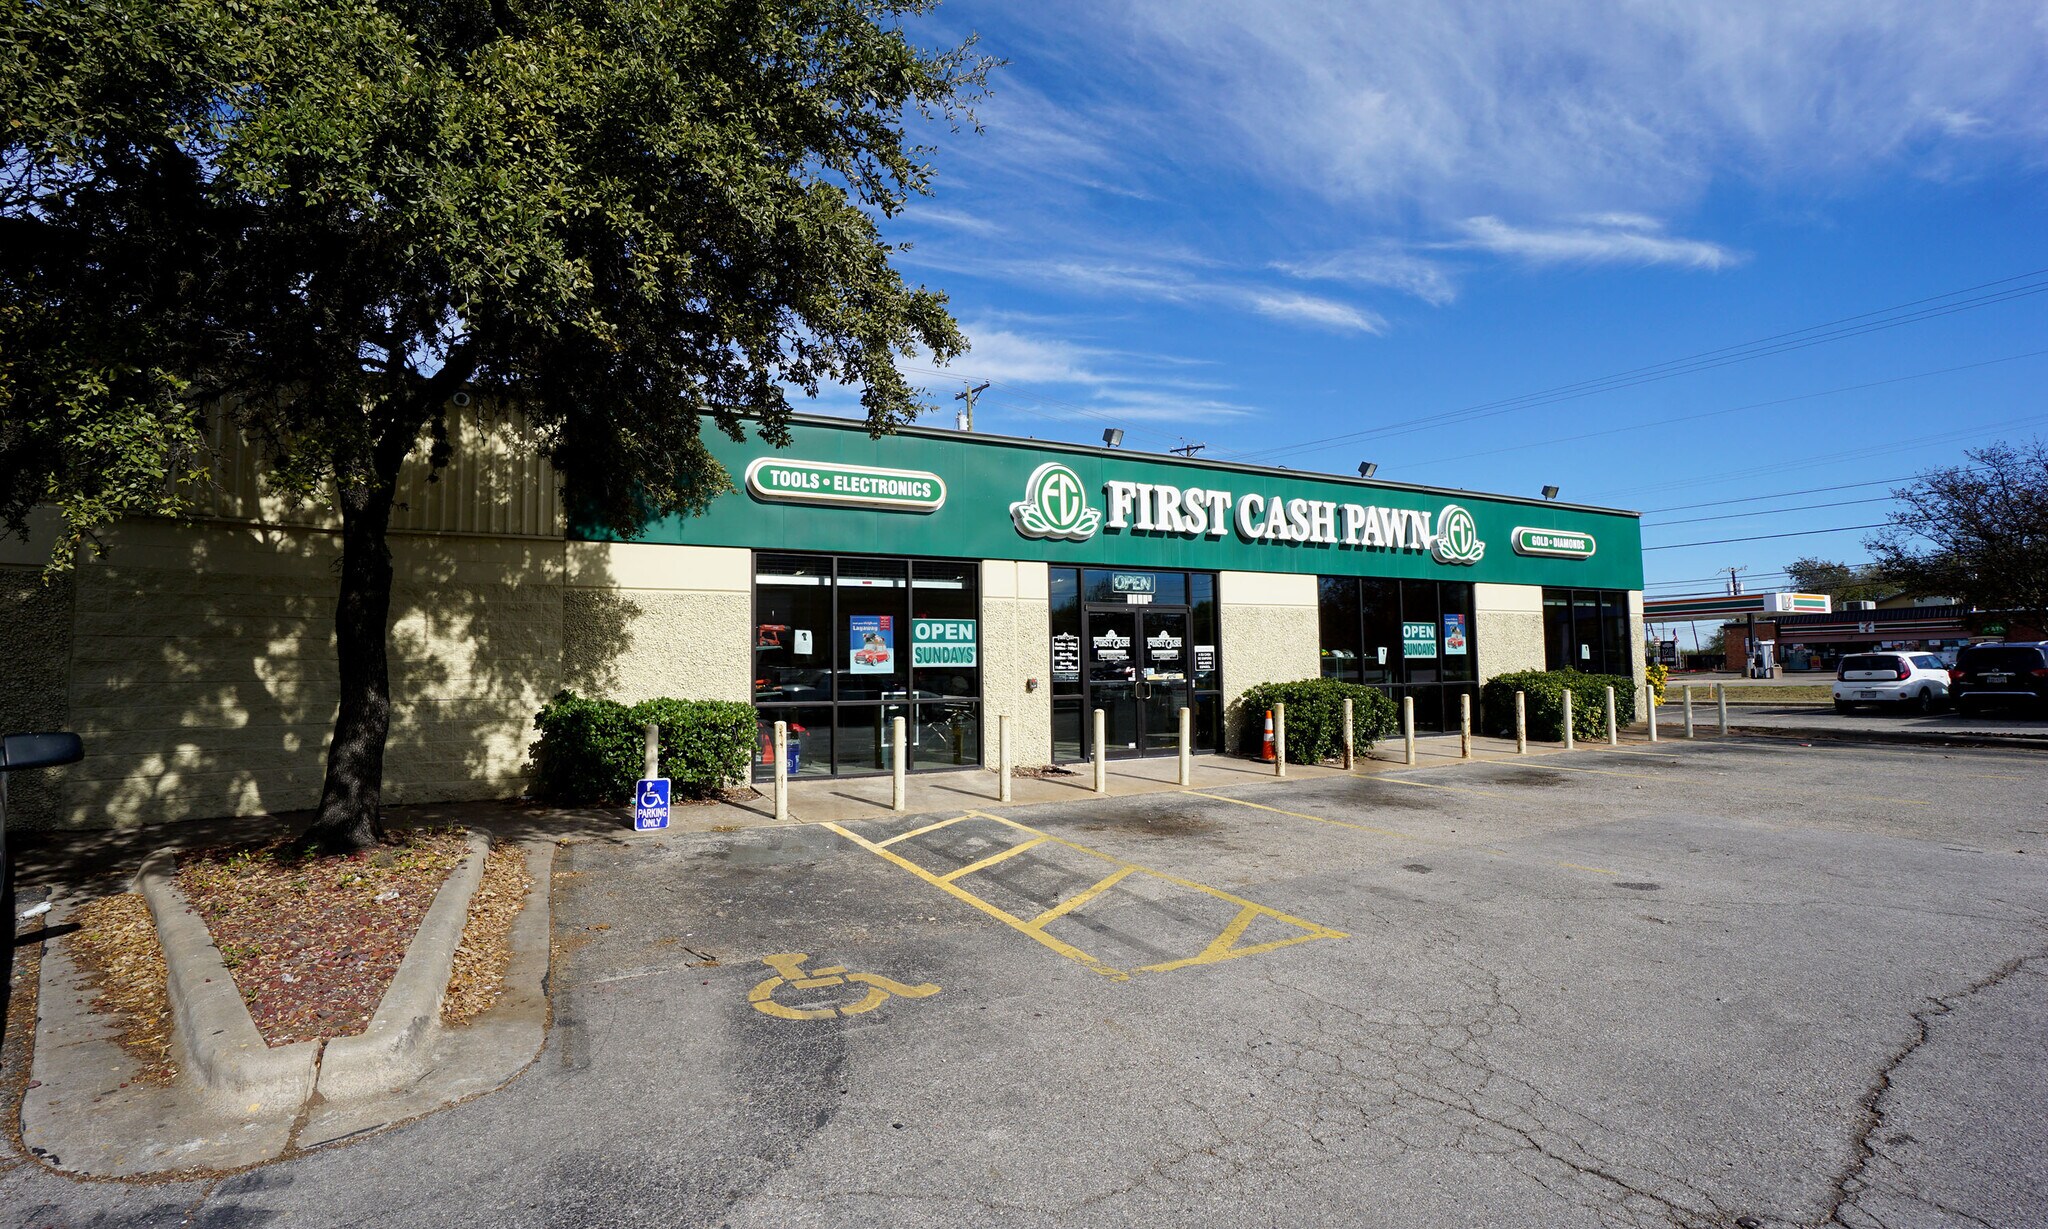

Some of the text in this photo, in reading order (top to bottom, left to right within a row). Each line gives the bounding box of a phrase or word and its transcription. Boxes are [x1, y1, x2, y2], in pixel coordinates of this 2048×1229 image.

[770, 469, 932, 498] TOOLS ELECTRONICS
[1105, 480, 1432, 550] FIRST CASH PAWN
[1531, 535, 1585, 550] GOLD DIAMONDS
[1114, 575, 1152, 591] OPEN
[915, 622, 973, 640] OPEN
[1403, 625, 1435, 638] OPEN
[915, 647, 974, 664] SUNDAYS
[1404, 643, 1435, 656] SUNDAYS
[638, 807, 667, 819] PARKING
[642, 817, 662, 828] ONLY
